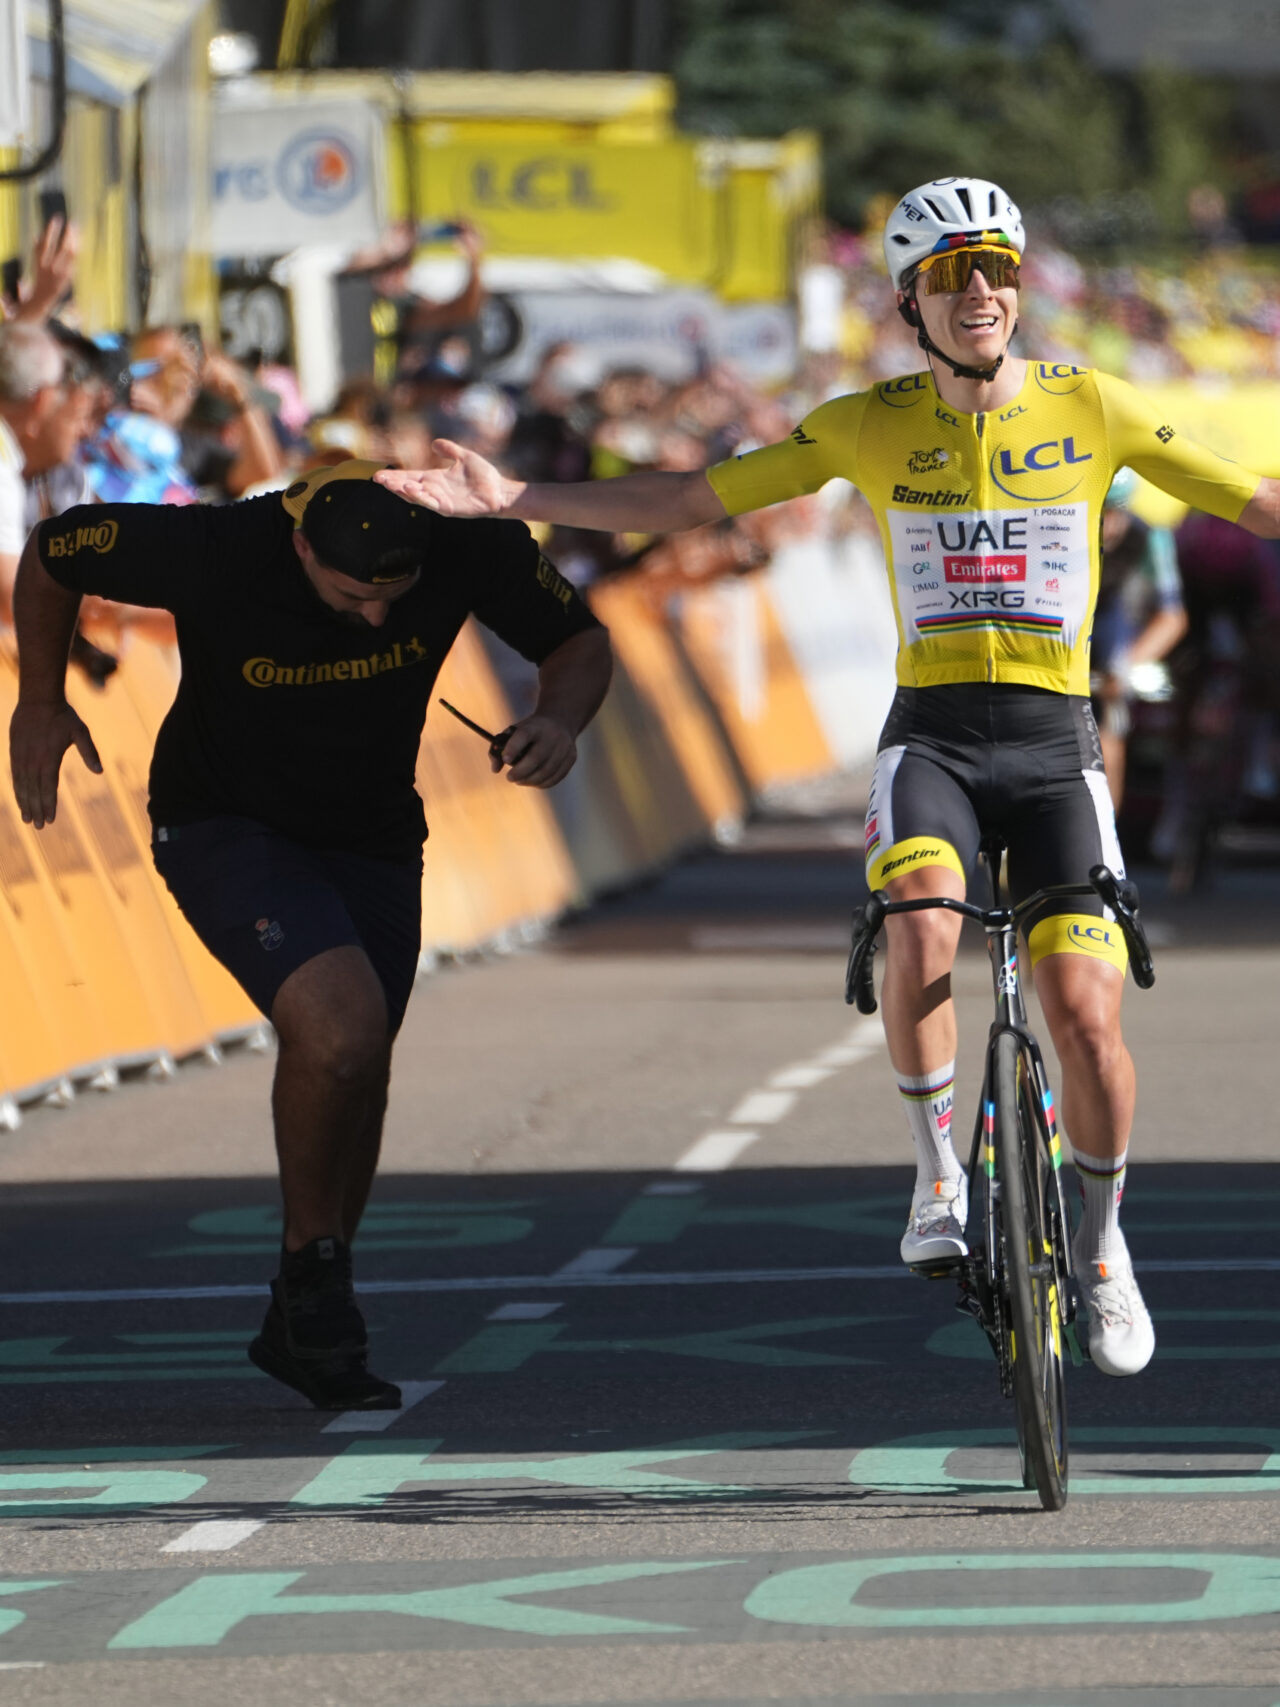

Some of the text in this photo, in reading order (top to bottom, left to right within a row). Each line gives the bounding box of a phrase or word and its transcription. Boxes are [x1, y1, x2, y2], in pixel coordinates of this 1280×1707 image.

[470, 157, 618, 213] LCL
[899, 200, 929, 222] MET
[1040, 364, 1087, 379] LCL
[884, 376, 926, 393] LCL
[935, 408, 960, 428] LCL
[1000, 405, 1028, 422] LCL
[1000, 437, 1092, 476] LCL
[892, 484, 971, 506] Santini
[937, 517, 1027, 551] UAE
[951, 563, 1018, 576] Emirates
[1051, 562, 1068, 572] IHC
[948, 591, 1024, 609] XRG
[242, 642, 403, 688] Continental
[881, 849, 940, 877] Santini
[1073, 925, 1115, 947] LCL
